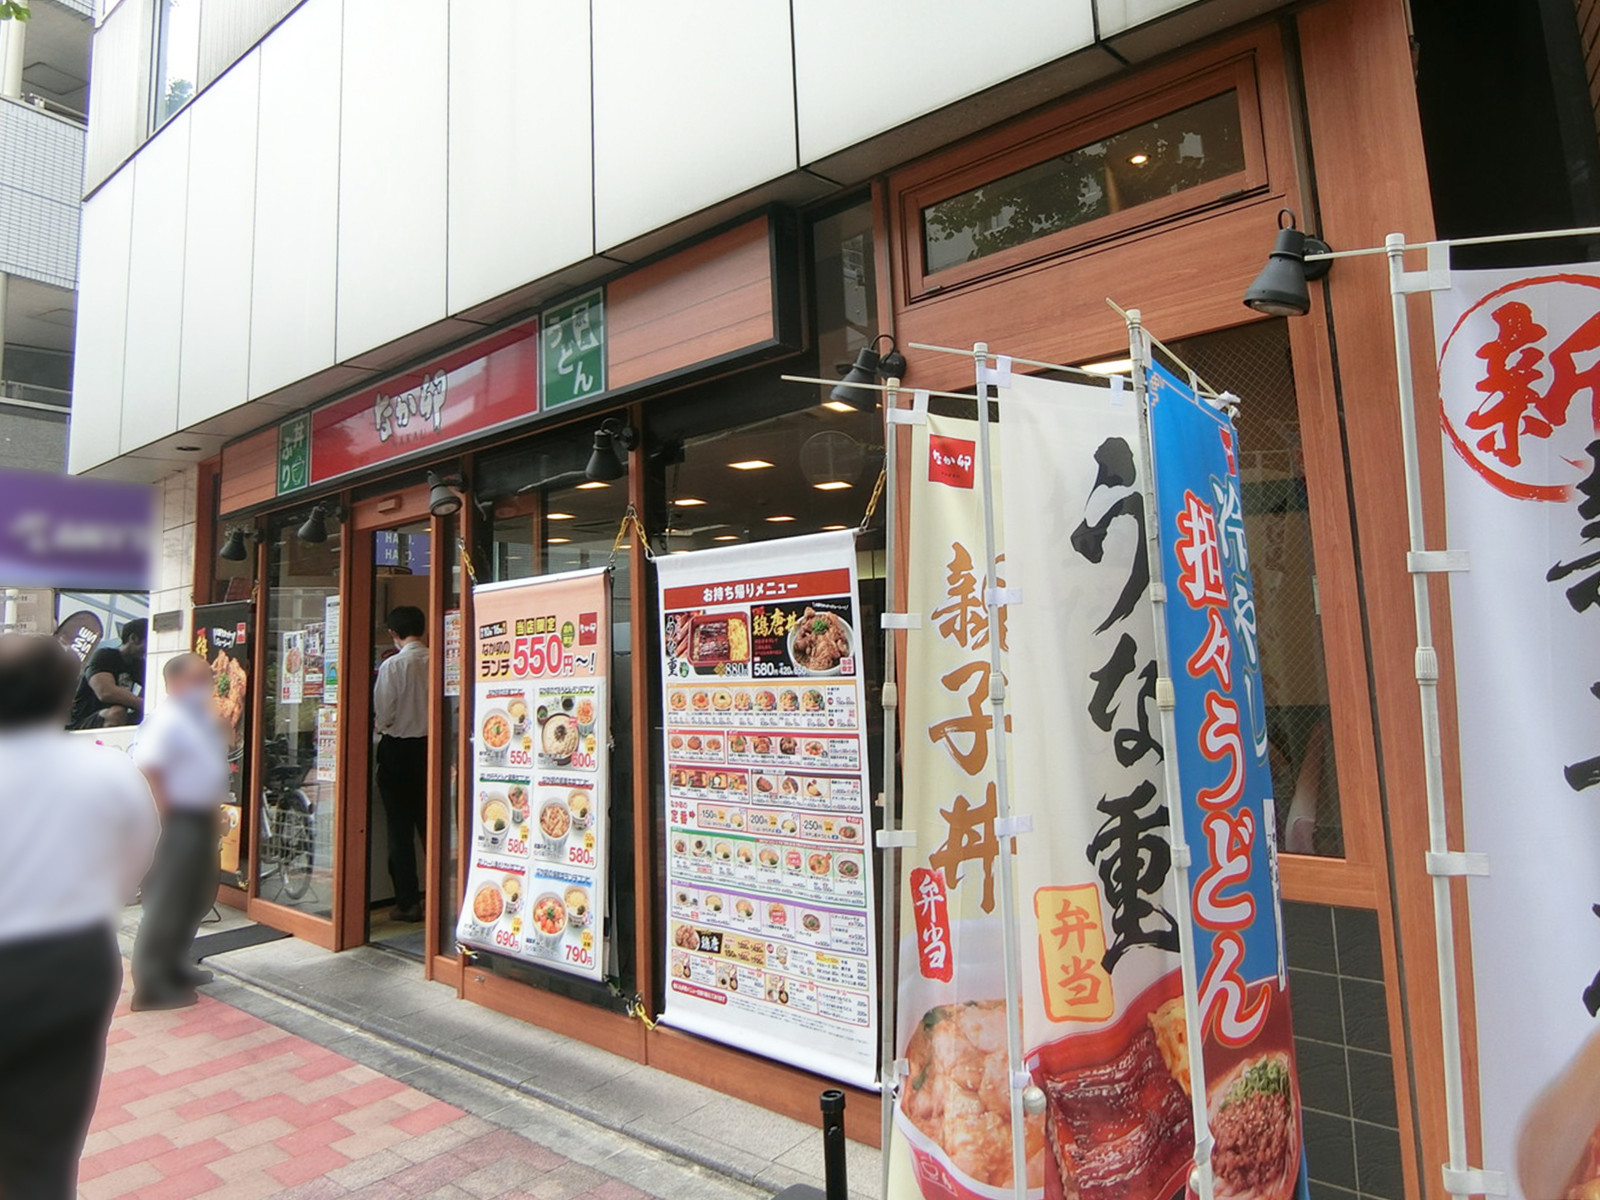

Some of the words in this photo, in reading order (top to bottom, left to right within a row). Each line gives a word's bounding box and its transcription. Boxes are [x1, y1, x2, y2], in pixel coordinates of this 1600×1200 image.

[374, 368, 448, 443] なか卯
[703, 582, 798, 602] お持ち帰りメニュー
[481, 659, 510, 677] ランチ
[1070, 437, 1180, 975] うな重
[510, 751, 531, 765] 550円
[571, 752, 595, 768] 600円
[507, 838, 528, 854] 580円
[569, 847, 594, 866] 580円
[914, 874, 945, 969] 弁当
[496, 929, 519, 949] 690円
[566, 944, 593, 965] 790円
[1050, 899, 1103, 1006] 弁当
